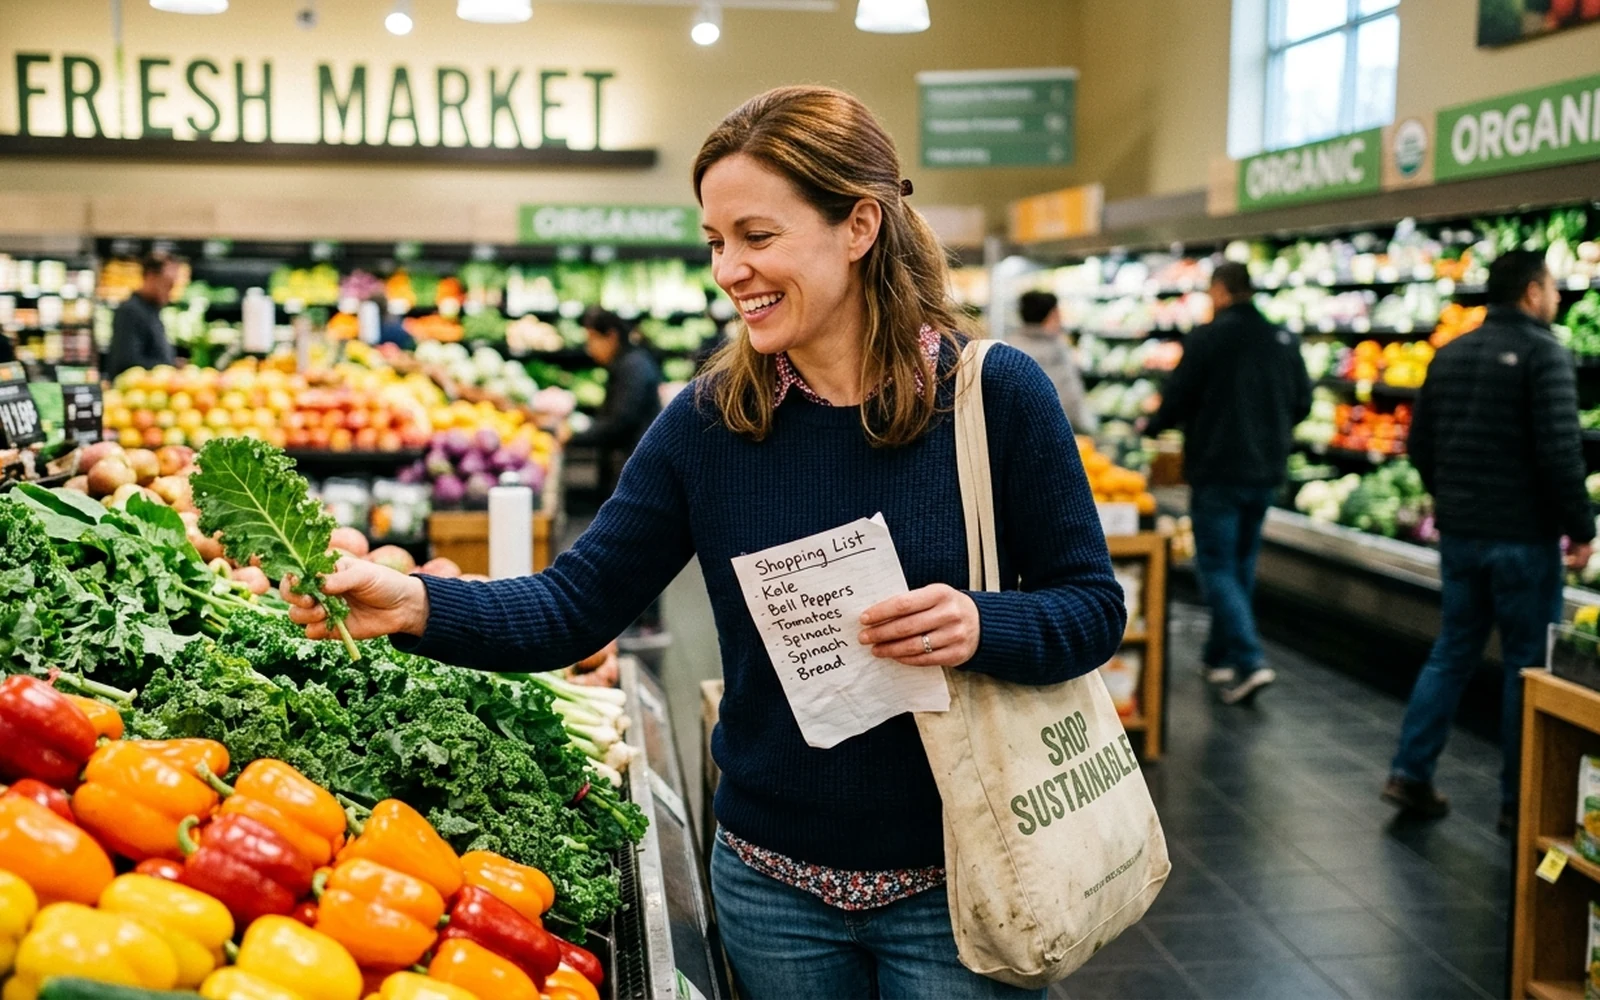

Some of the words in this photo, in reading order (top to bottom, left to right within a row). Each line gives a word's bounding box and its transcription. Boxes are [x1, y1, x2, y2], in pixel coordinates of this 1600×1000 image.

[15, 54, 272, 140] FRESH
[318, 65, 614, 150] MARKET
[1452, 89, 1600, 165] ORGANI
[1245, 137, 1366, 200] ORGANIC
[533, 207, 685, 239] ORGANIC
[755, 548, 828, 575] Shopping
[832, 531, 865, 552] List
[767, 599, 797, 617] Bell
[800, 585, 854, 608] Peppers
[772, 608, 842, 631] Tomatoes
[782, 624, 841, 648] Spinach
[787, 637, 848, 664] Spinach
[796, 654, 845, 680] Bread
[1040, 710, 1090, 766] SHOP
[1010, 733, 1138, 835] SUSTAINABLE
